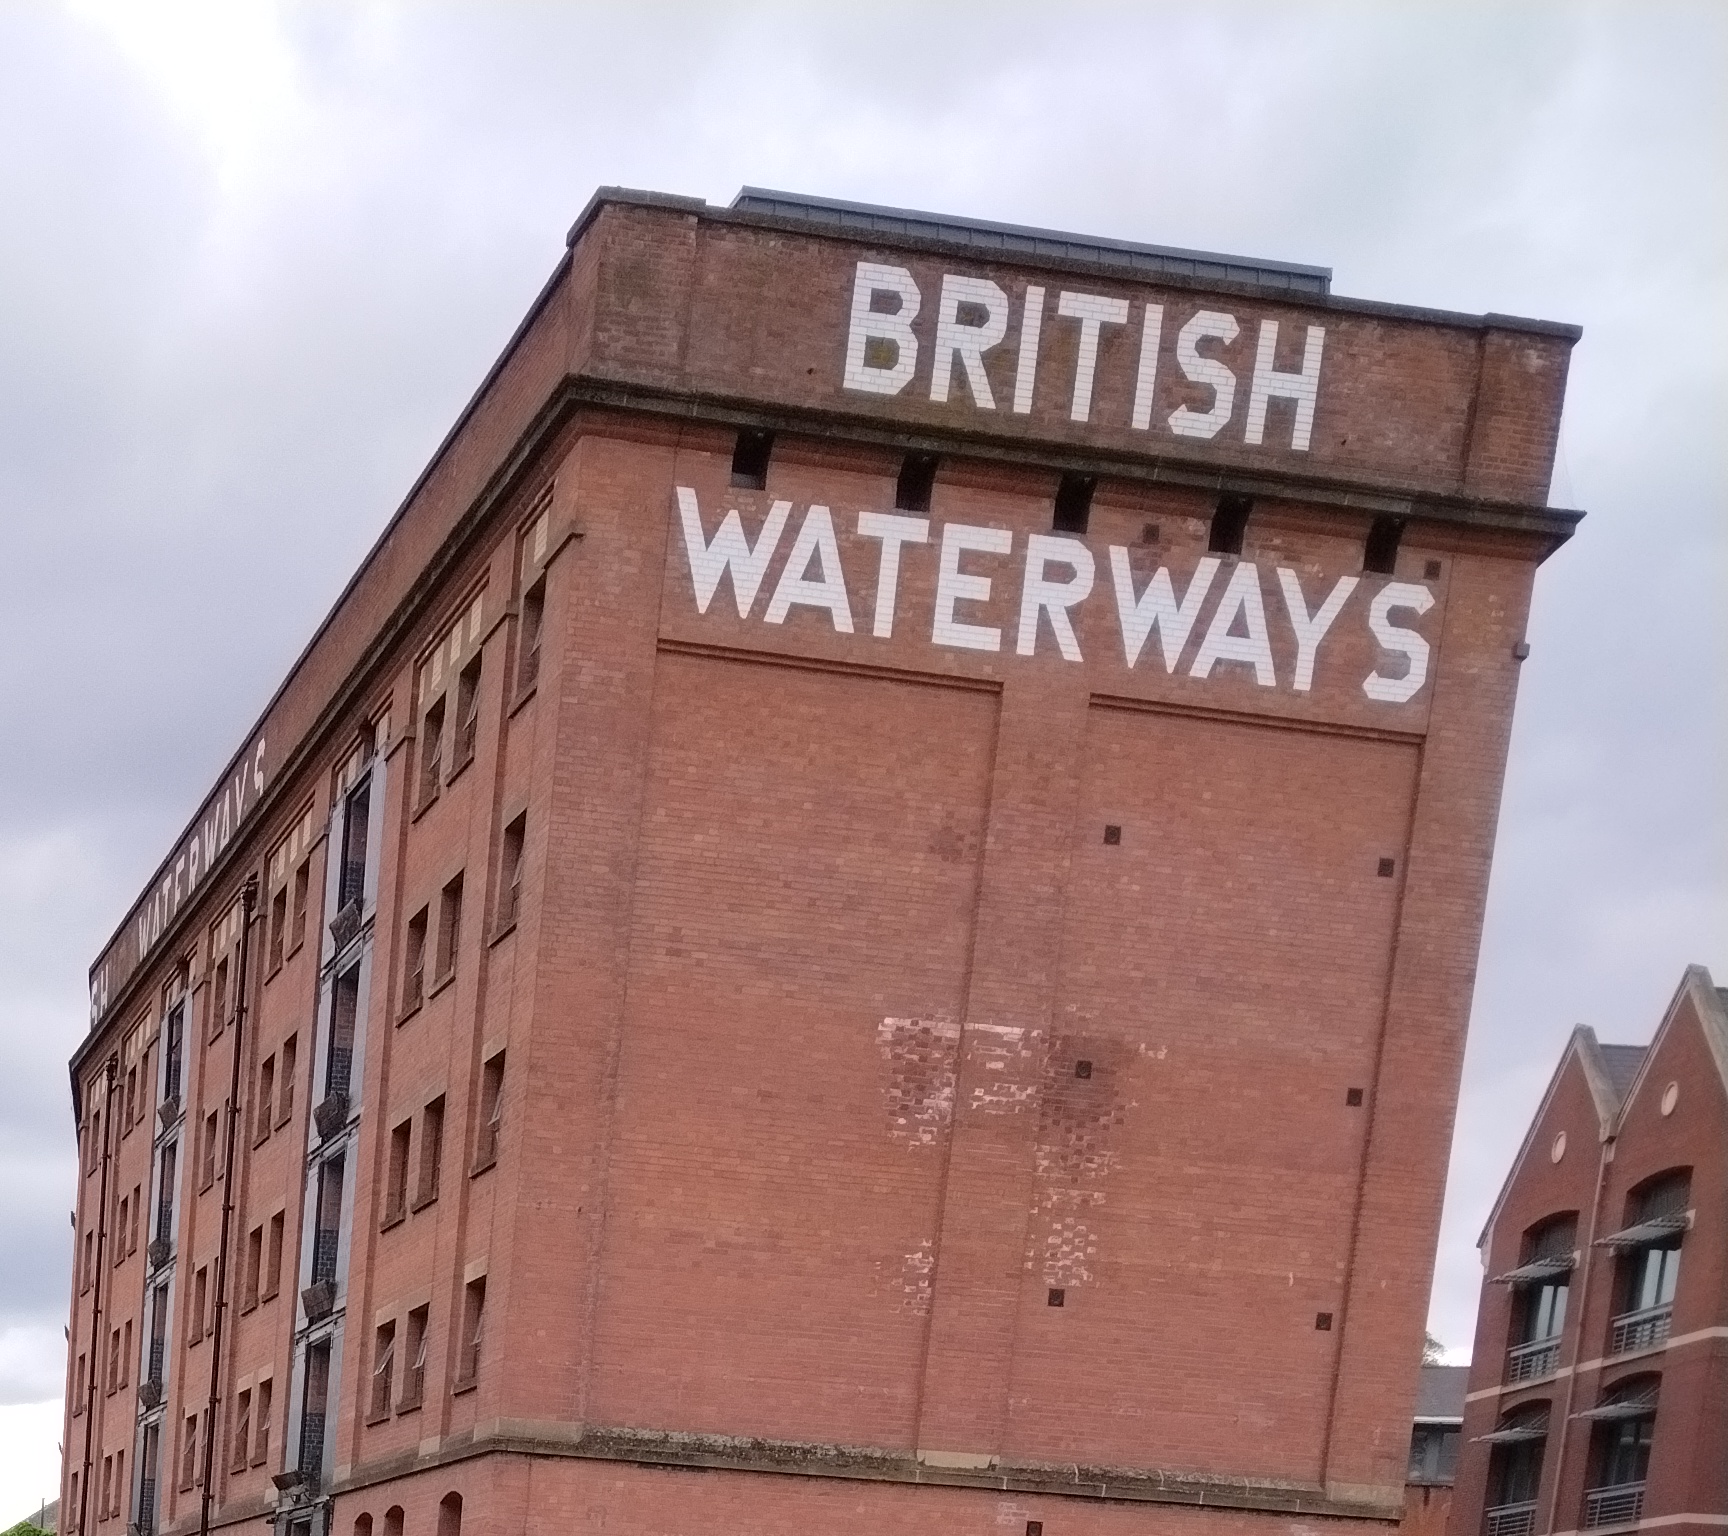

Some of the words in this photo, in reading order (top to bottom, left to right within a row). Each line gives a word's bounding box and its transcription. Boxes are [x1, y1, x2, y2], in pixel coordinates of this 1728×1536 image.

[842, 260, 1326, 452] BRITISH
[675, 486, 1436, 703] WATERWAYS
[138, 736, 266, 964] WATERWAYS
